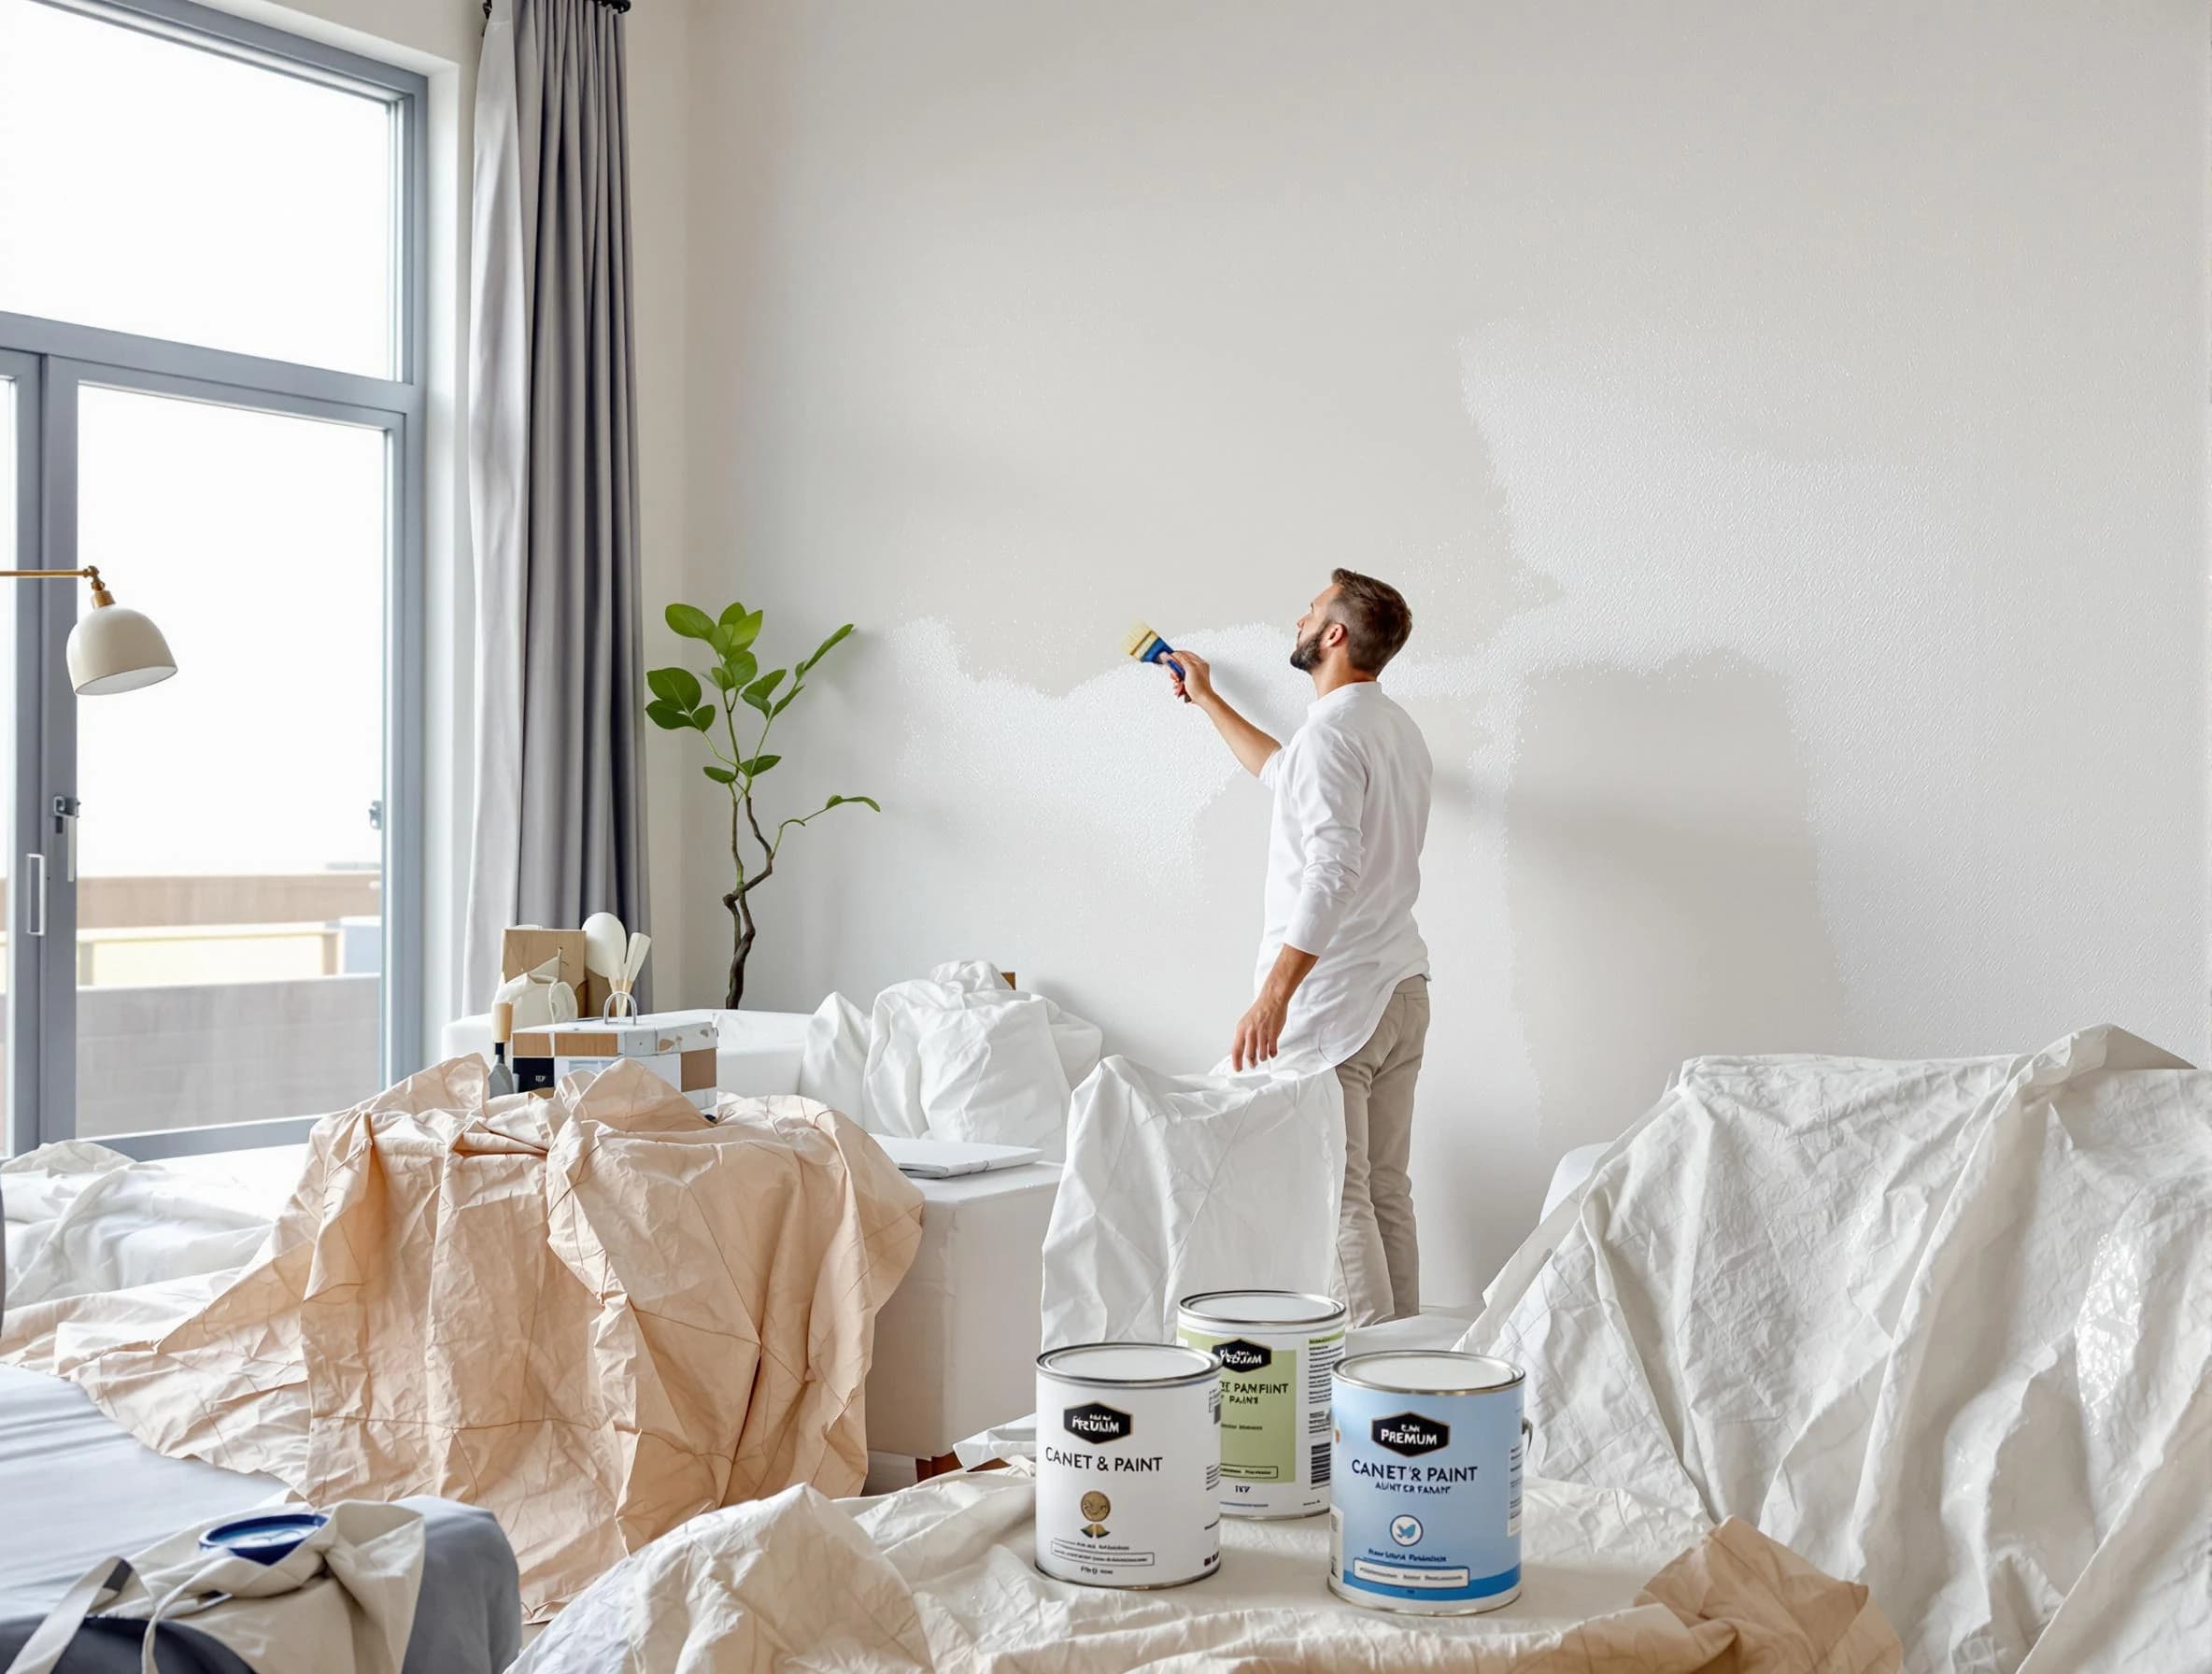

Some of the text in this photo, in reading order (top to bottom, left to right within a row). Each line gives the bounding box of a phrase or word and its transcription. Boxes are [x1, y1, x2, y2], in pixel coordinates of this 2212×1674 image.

[1045, 1446, 1164, 1472] CANET & PAINT
[1411, 1467, 1422, 1482] &
[1427, 1466, 1479, 1482] PAINT
